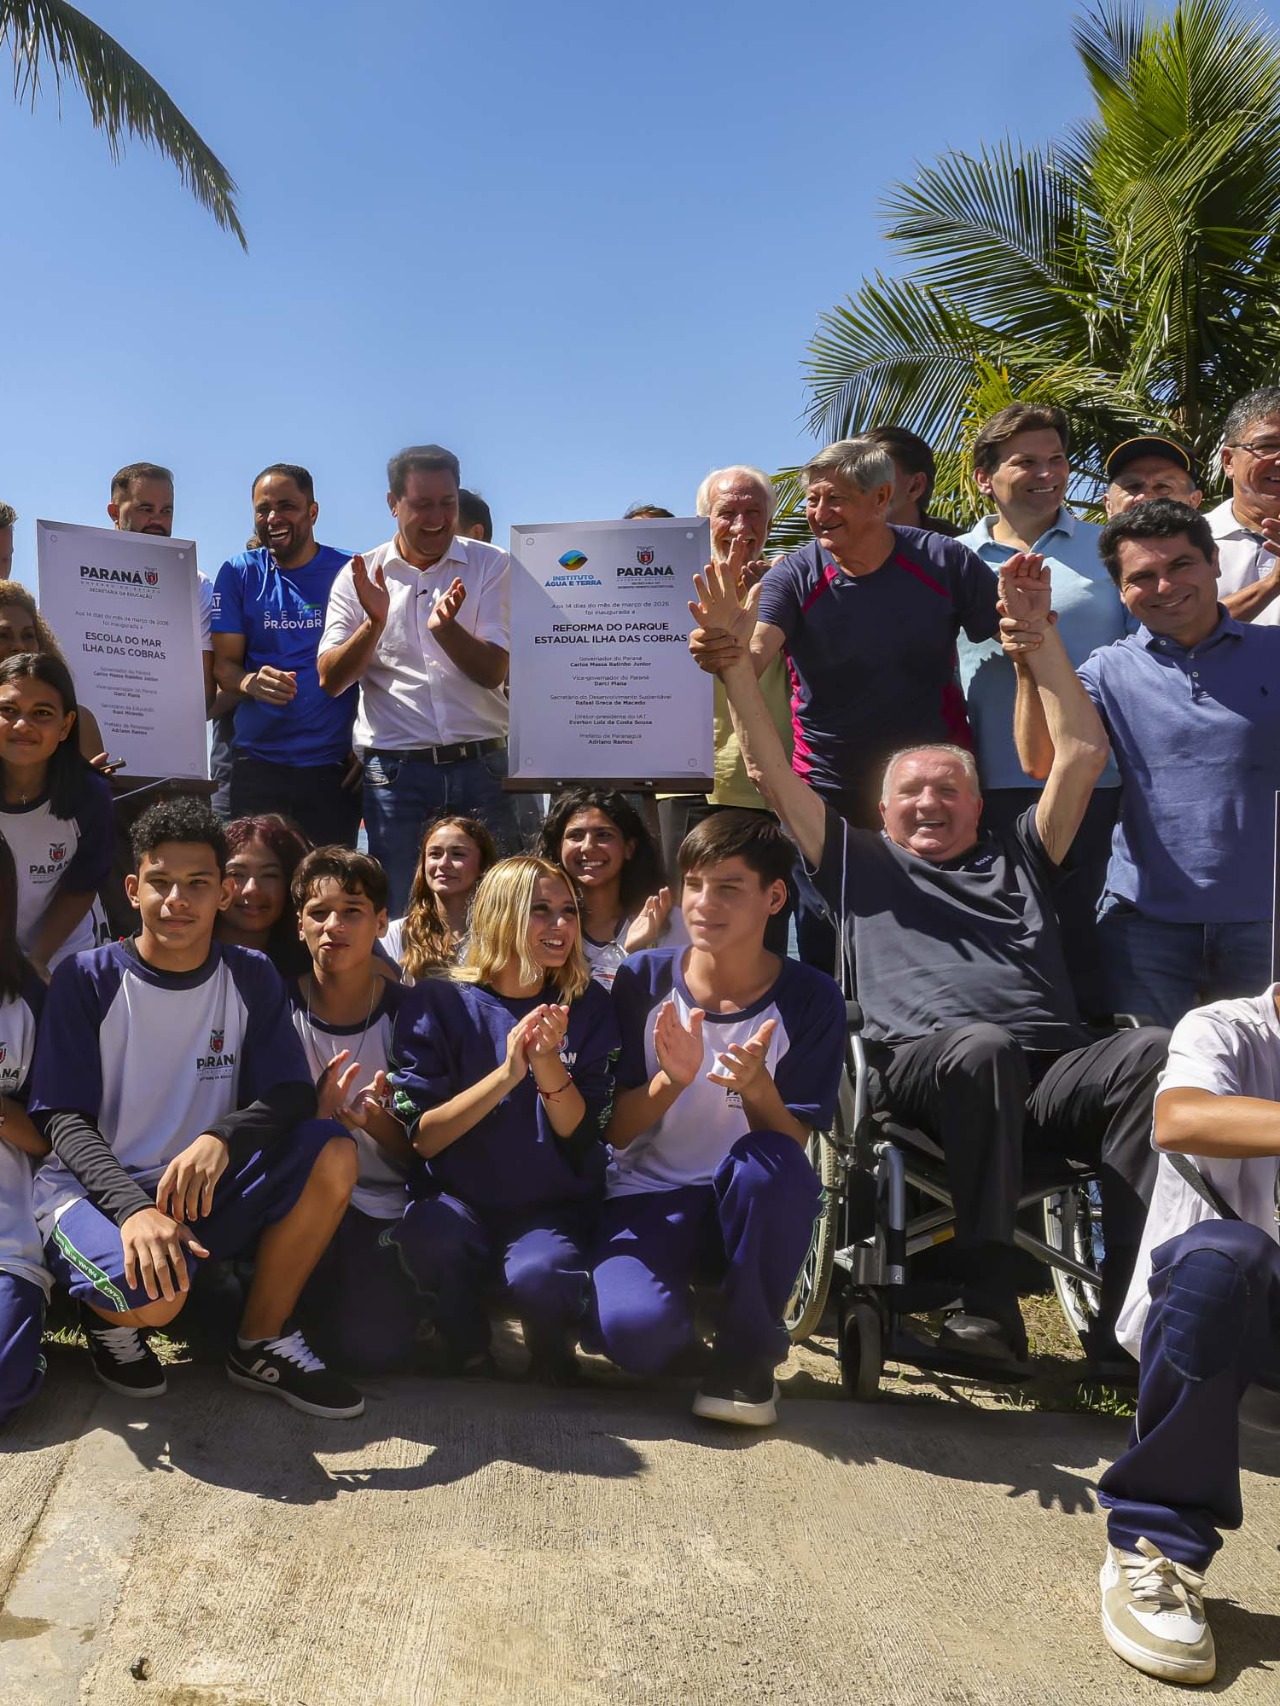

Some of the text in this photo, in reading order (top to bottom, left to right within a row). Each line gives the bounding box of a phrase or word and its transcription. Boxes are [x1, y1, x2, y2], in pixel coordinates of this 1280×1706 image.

[80, 566, 143, 584] PARANÁ
[617, 564, 674, 576] PARANÁ
[264, 618, 322, 630] PR.GOV.BR
[552, 623, 669, 632] REFORMA DO PARQUE
[85, 632, 161, 647] ESCOLA DO MAR
[534, 634, 688, 644] ESTADUAL ILHA DAS COBRAS
[82, 643, 166, 660] ILHA DAS COBRAS
[30, 860, 70, 875] PARAN
